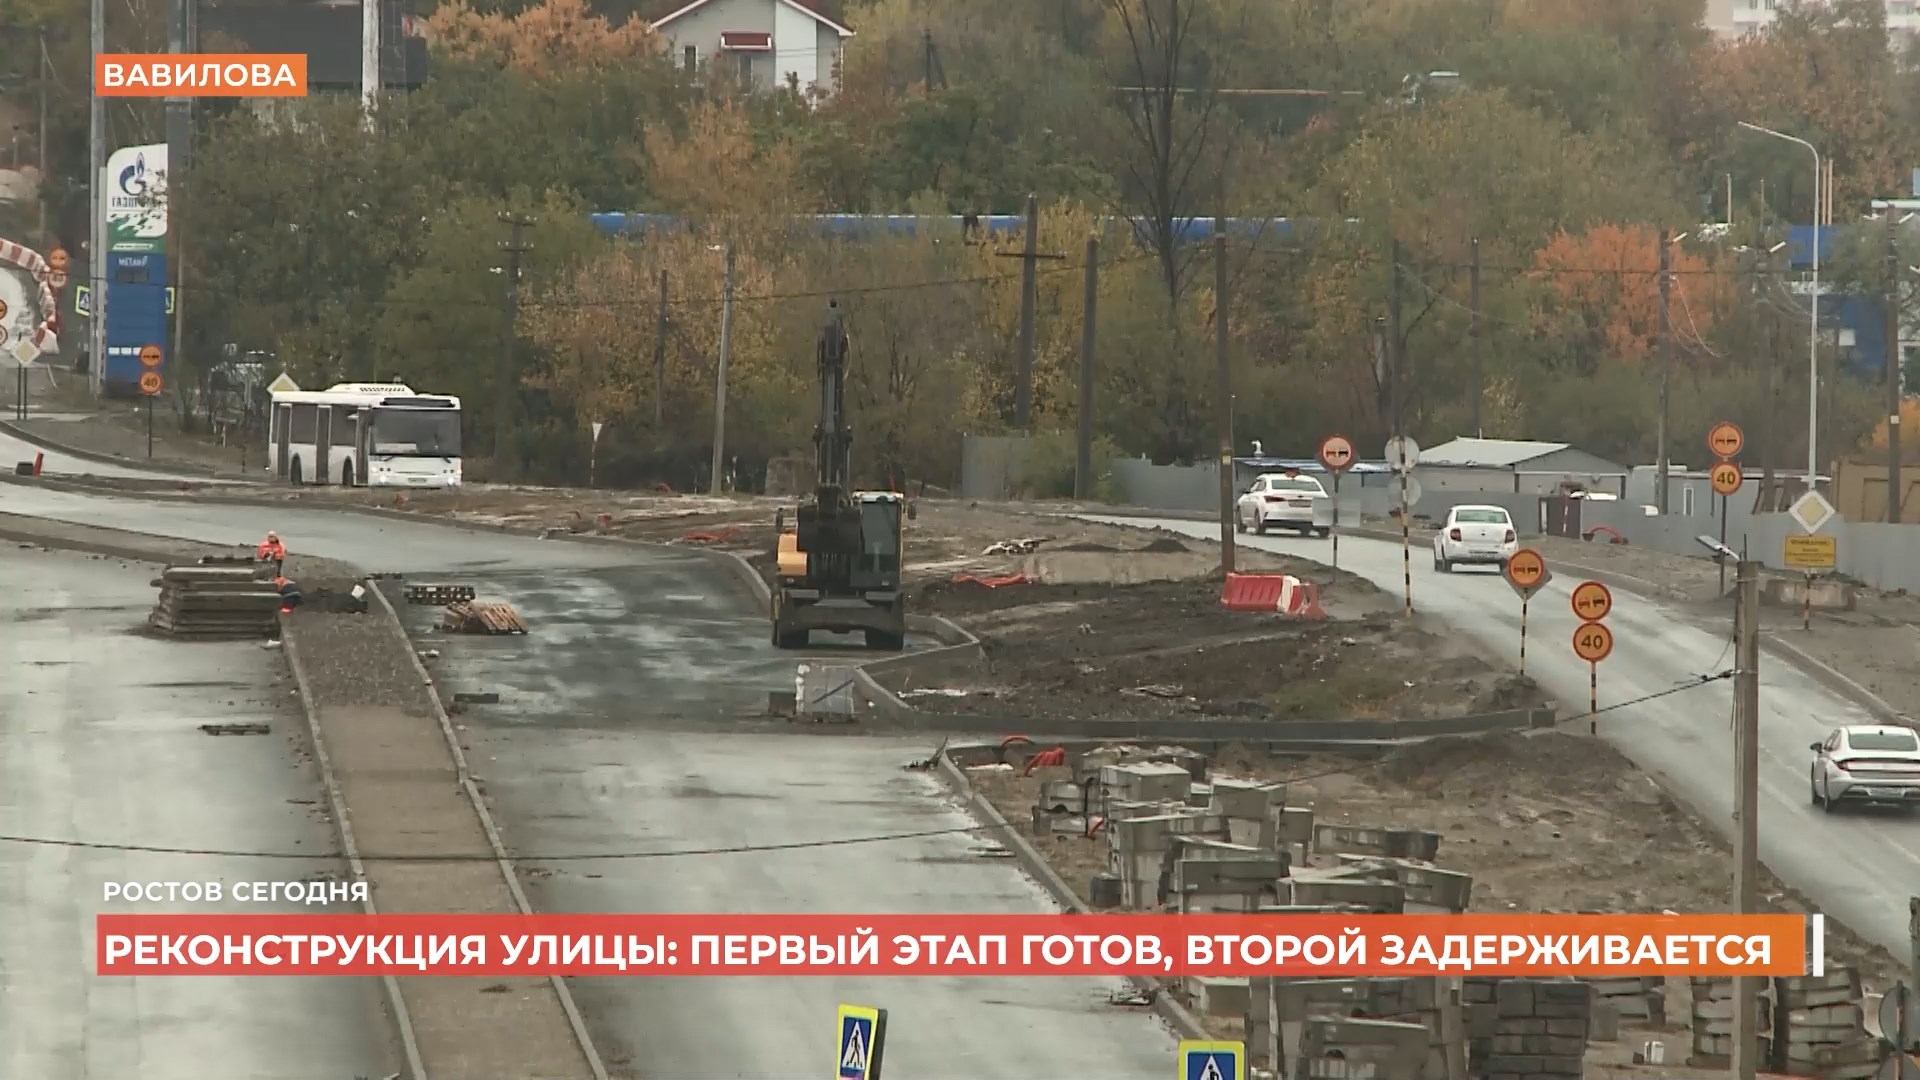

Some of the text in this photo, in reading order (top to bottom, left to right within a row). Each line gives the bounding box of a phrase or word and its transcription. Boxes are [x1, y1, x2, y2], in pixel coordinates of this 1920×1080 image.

[143, 377, 158, 388] 40
[1716, 471, 1736, 485] 40
[1580, 634, 1604, 650] 40
